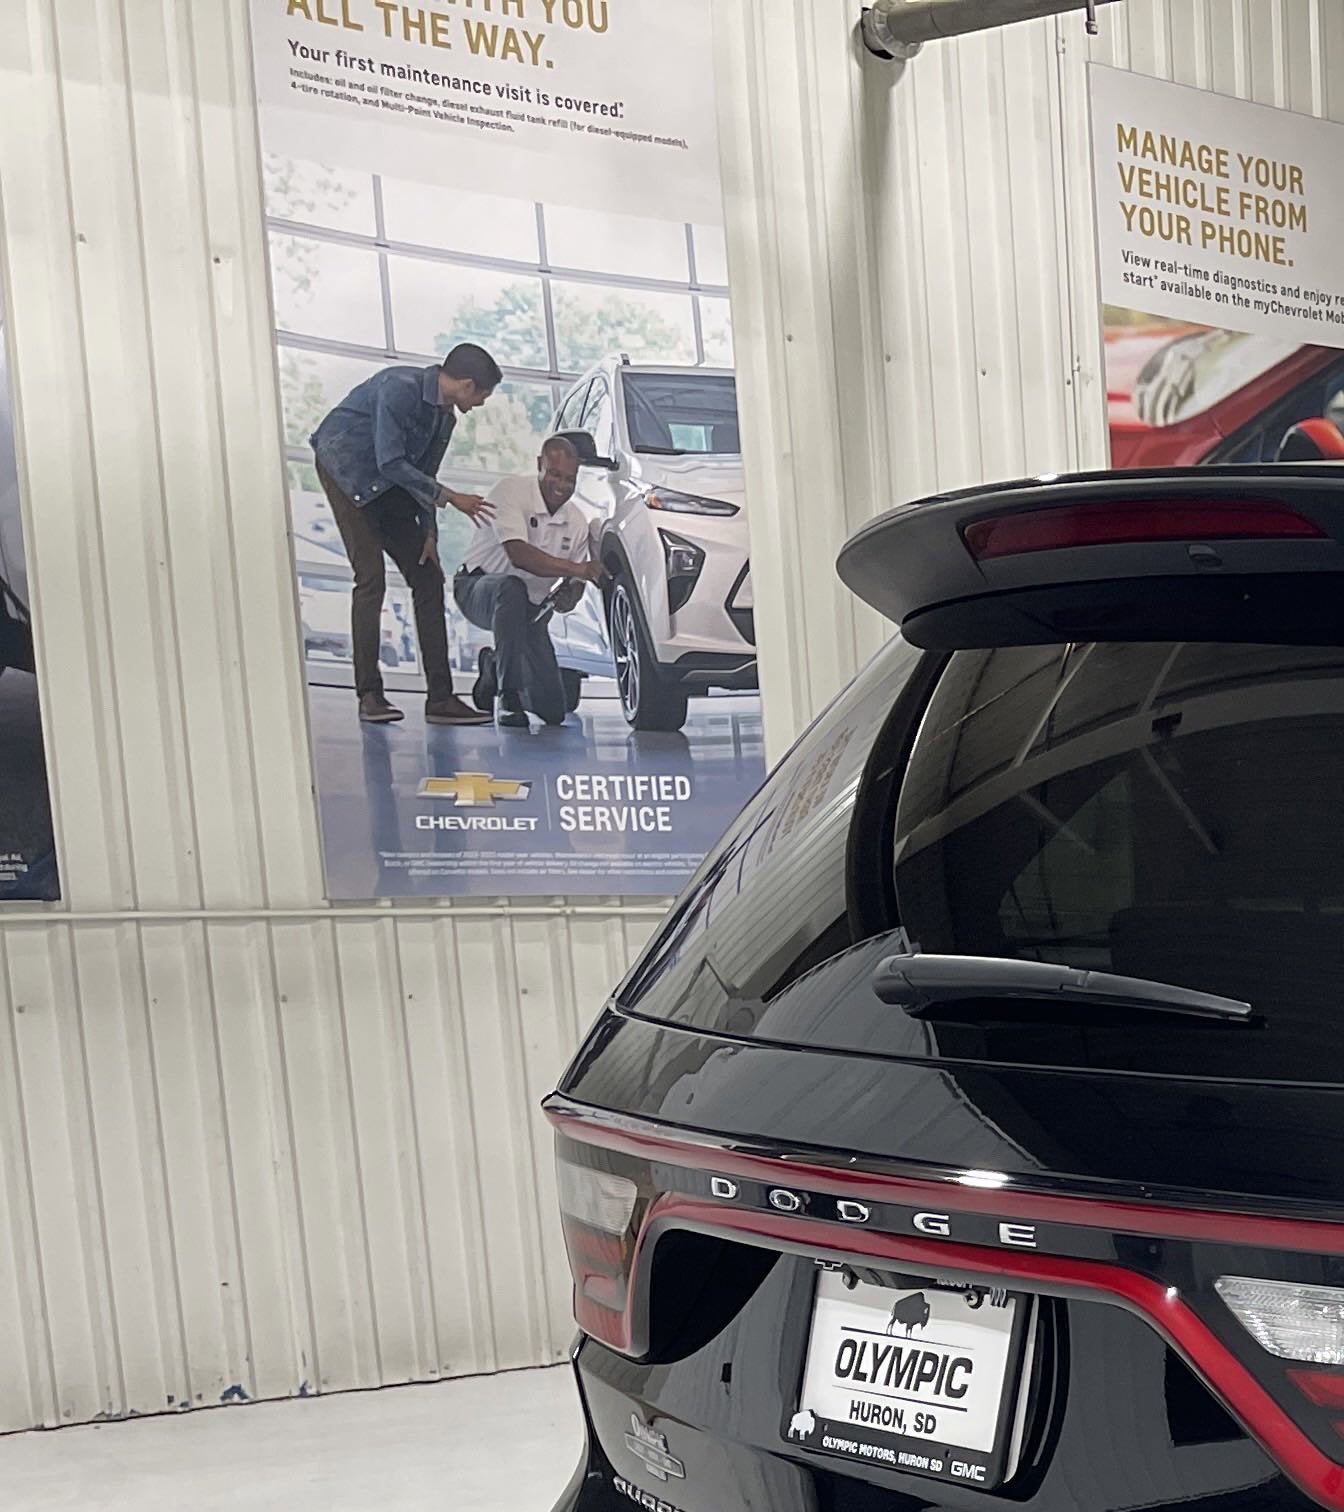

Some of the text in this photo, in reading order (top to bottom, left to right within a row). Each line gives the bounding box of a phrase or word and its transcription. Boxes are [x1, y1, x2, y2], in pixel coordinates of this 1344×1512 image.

[375, 0, 452, 50] THE
[463, 18, 554, 69] WAY.
[288, 38, 330, 63] Your
[335, 49, 375, 74] first
[381, 63, 491, 96] maintenance
[496, 83, 532, 103] visit
[536, 88, 550, 106] is
[1116, 123, 1305, 196] MANAGE YOUR
[1117, 162, 1308, 233] VEHICLE FROM
[1119, 201, 1295, 267] YOUR PHONE.
[1121, 249, 1151, 269] View
[1154, 255, 1210, 282] real-time
[1213, 269, 1278, 297] diagnostics
[1280, 278, 1300, 300] and
[1303, 286, 1332, 311] enjoy
[1160, 277, 1212, 302] available
[1214, 291, 1229, 305] on
[1232, 289, 1250, 308] the
[1253, 298, 1324, 323] myChevrolet
[556, 774, 692, 801] CERTIFIED
[415, 814, 538, 831] CHEVROLET
[559, 806, 673, 833] SERVICE
[711, 1176, 1038, 1248] DODGE
[834, 1338, 973, 1399] OLYMPIC
[849, 1400, 937, 1435] HURON, SD
[822, 1435, 987, 1482] OLYMPIC MOTORS, HURON SD GMC
